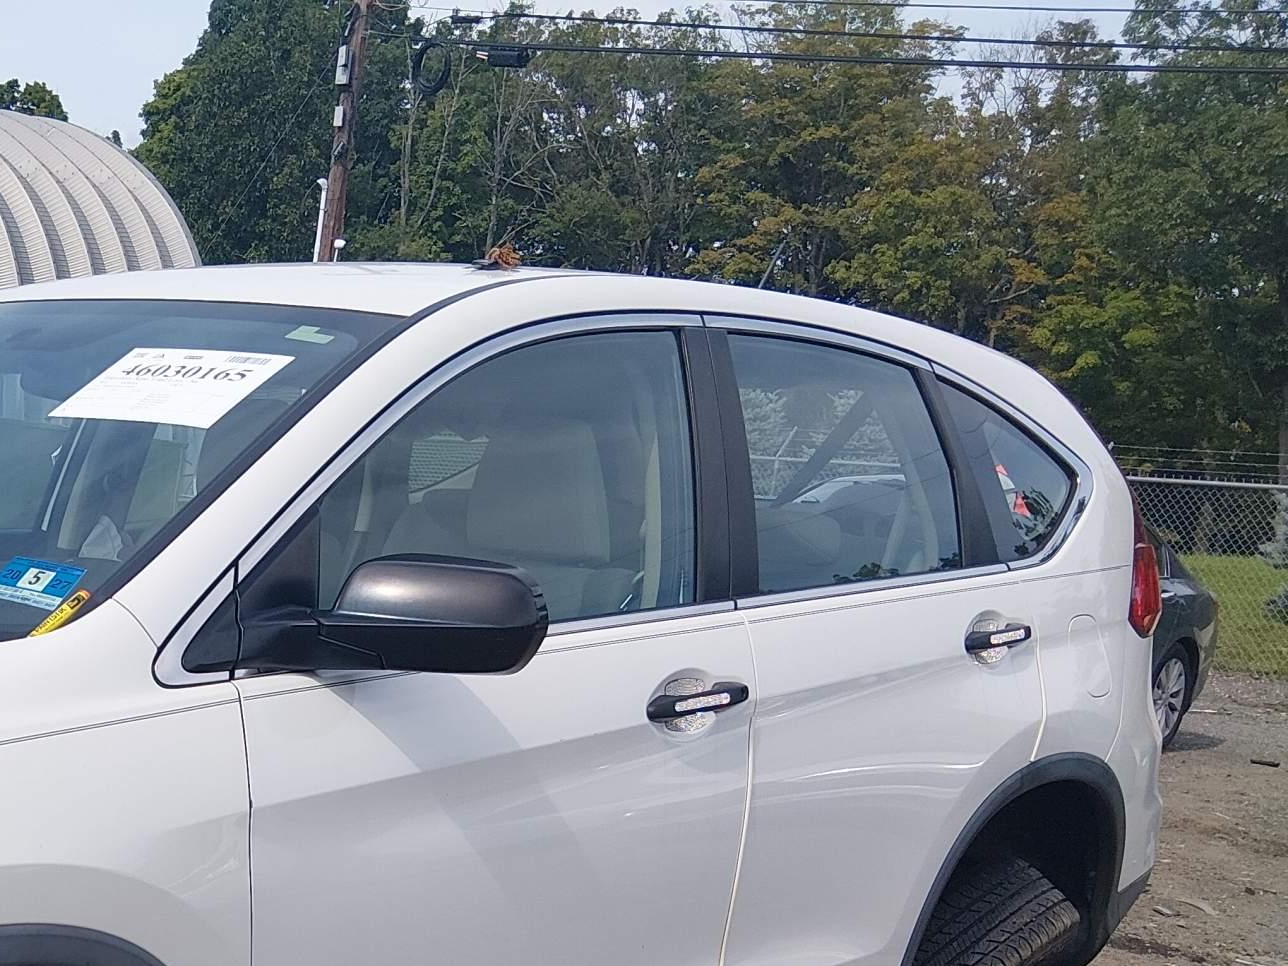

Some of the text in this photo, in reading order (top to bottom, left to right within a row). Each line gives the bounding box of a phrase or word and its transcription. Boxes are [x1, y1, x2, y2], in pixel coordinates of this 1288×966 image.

[122, 363, 255, 382] 46030165
[2, 568, 71, 591] 20 5 27
